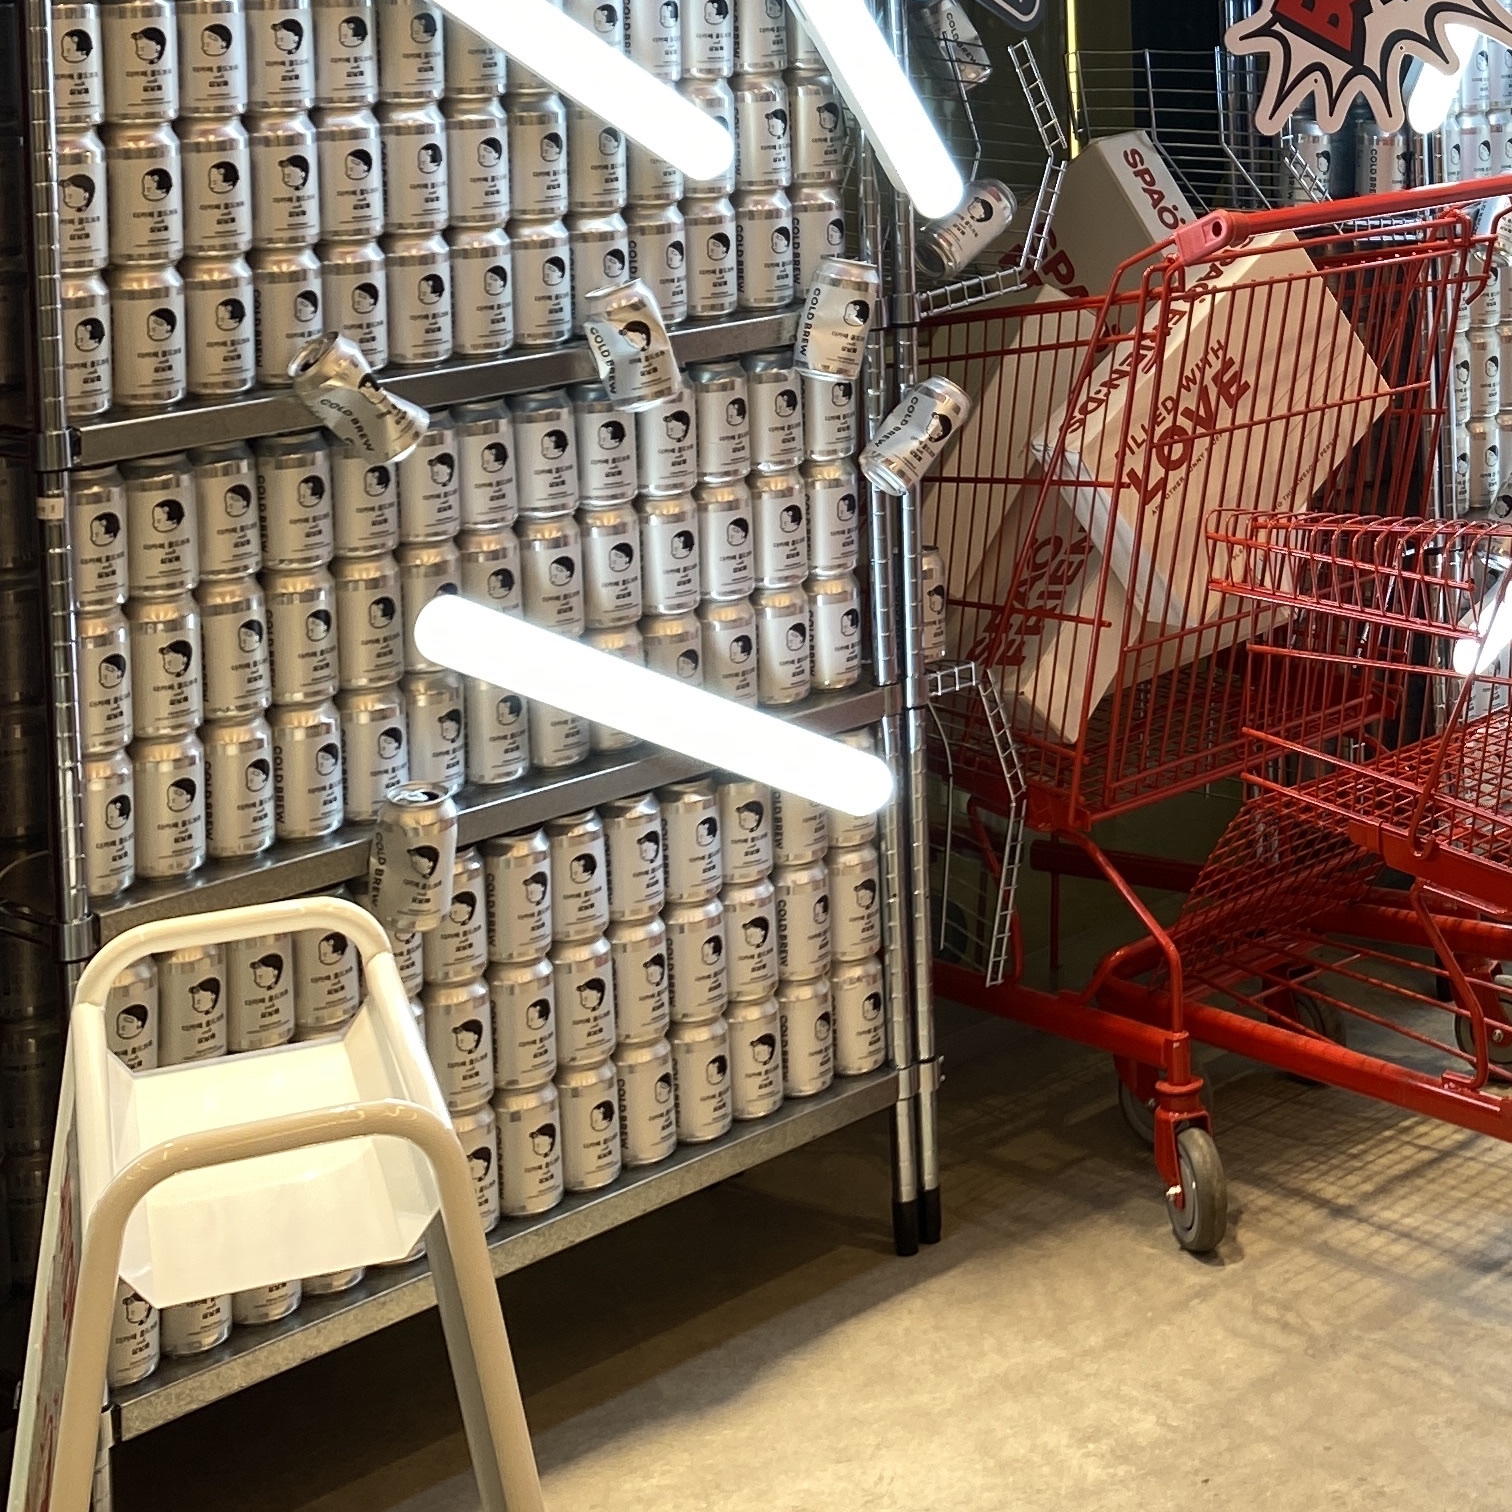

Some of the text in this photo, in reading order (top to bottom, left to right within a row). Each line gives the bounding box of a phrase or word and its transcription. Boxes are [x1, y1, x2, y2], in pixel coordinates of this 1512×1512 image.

[946, 12, 977, 64] COLD BREW
[800, 288, 821, 356] COLD BREW
[590, 327, 617, 394] COLD BREW
[1180, 339, 1225, 392] WITH
[320, 398, 375, 451] COLD BREW
[875, 396, 918, 448] COLD BREW
[1126, 356, 1251, 506] LOVE
[274, 746, 286, 824] COLD BREW
[370, 832, 385, 905] COLD BREW
[779, 899, 788, 967] COLD BREW
